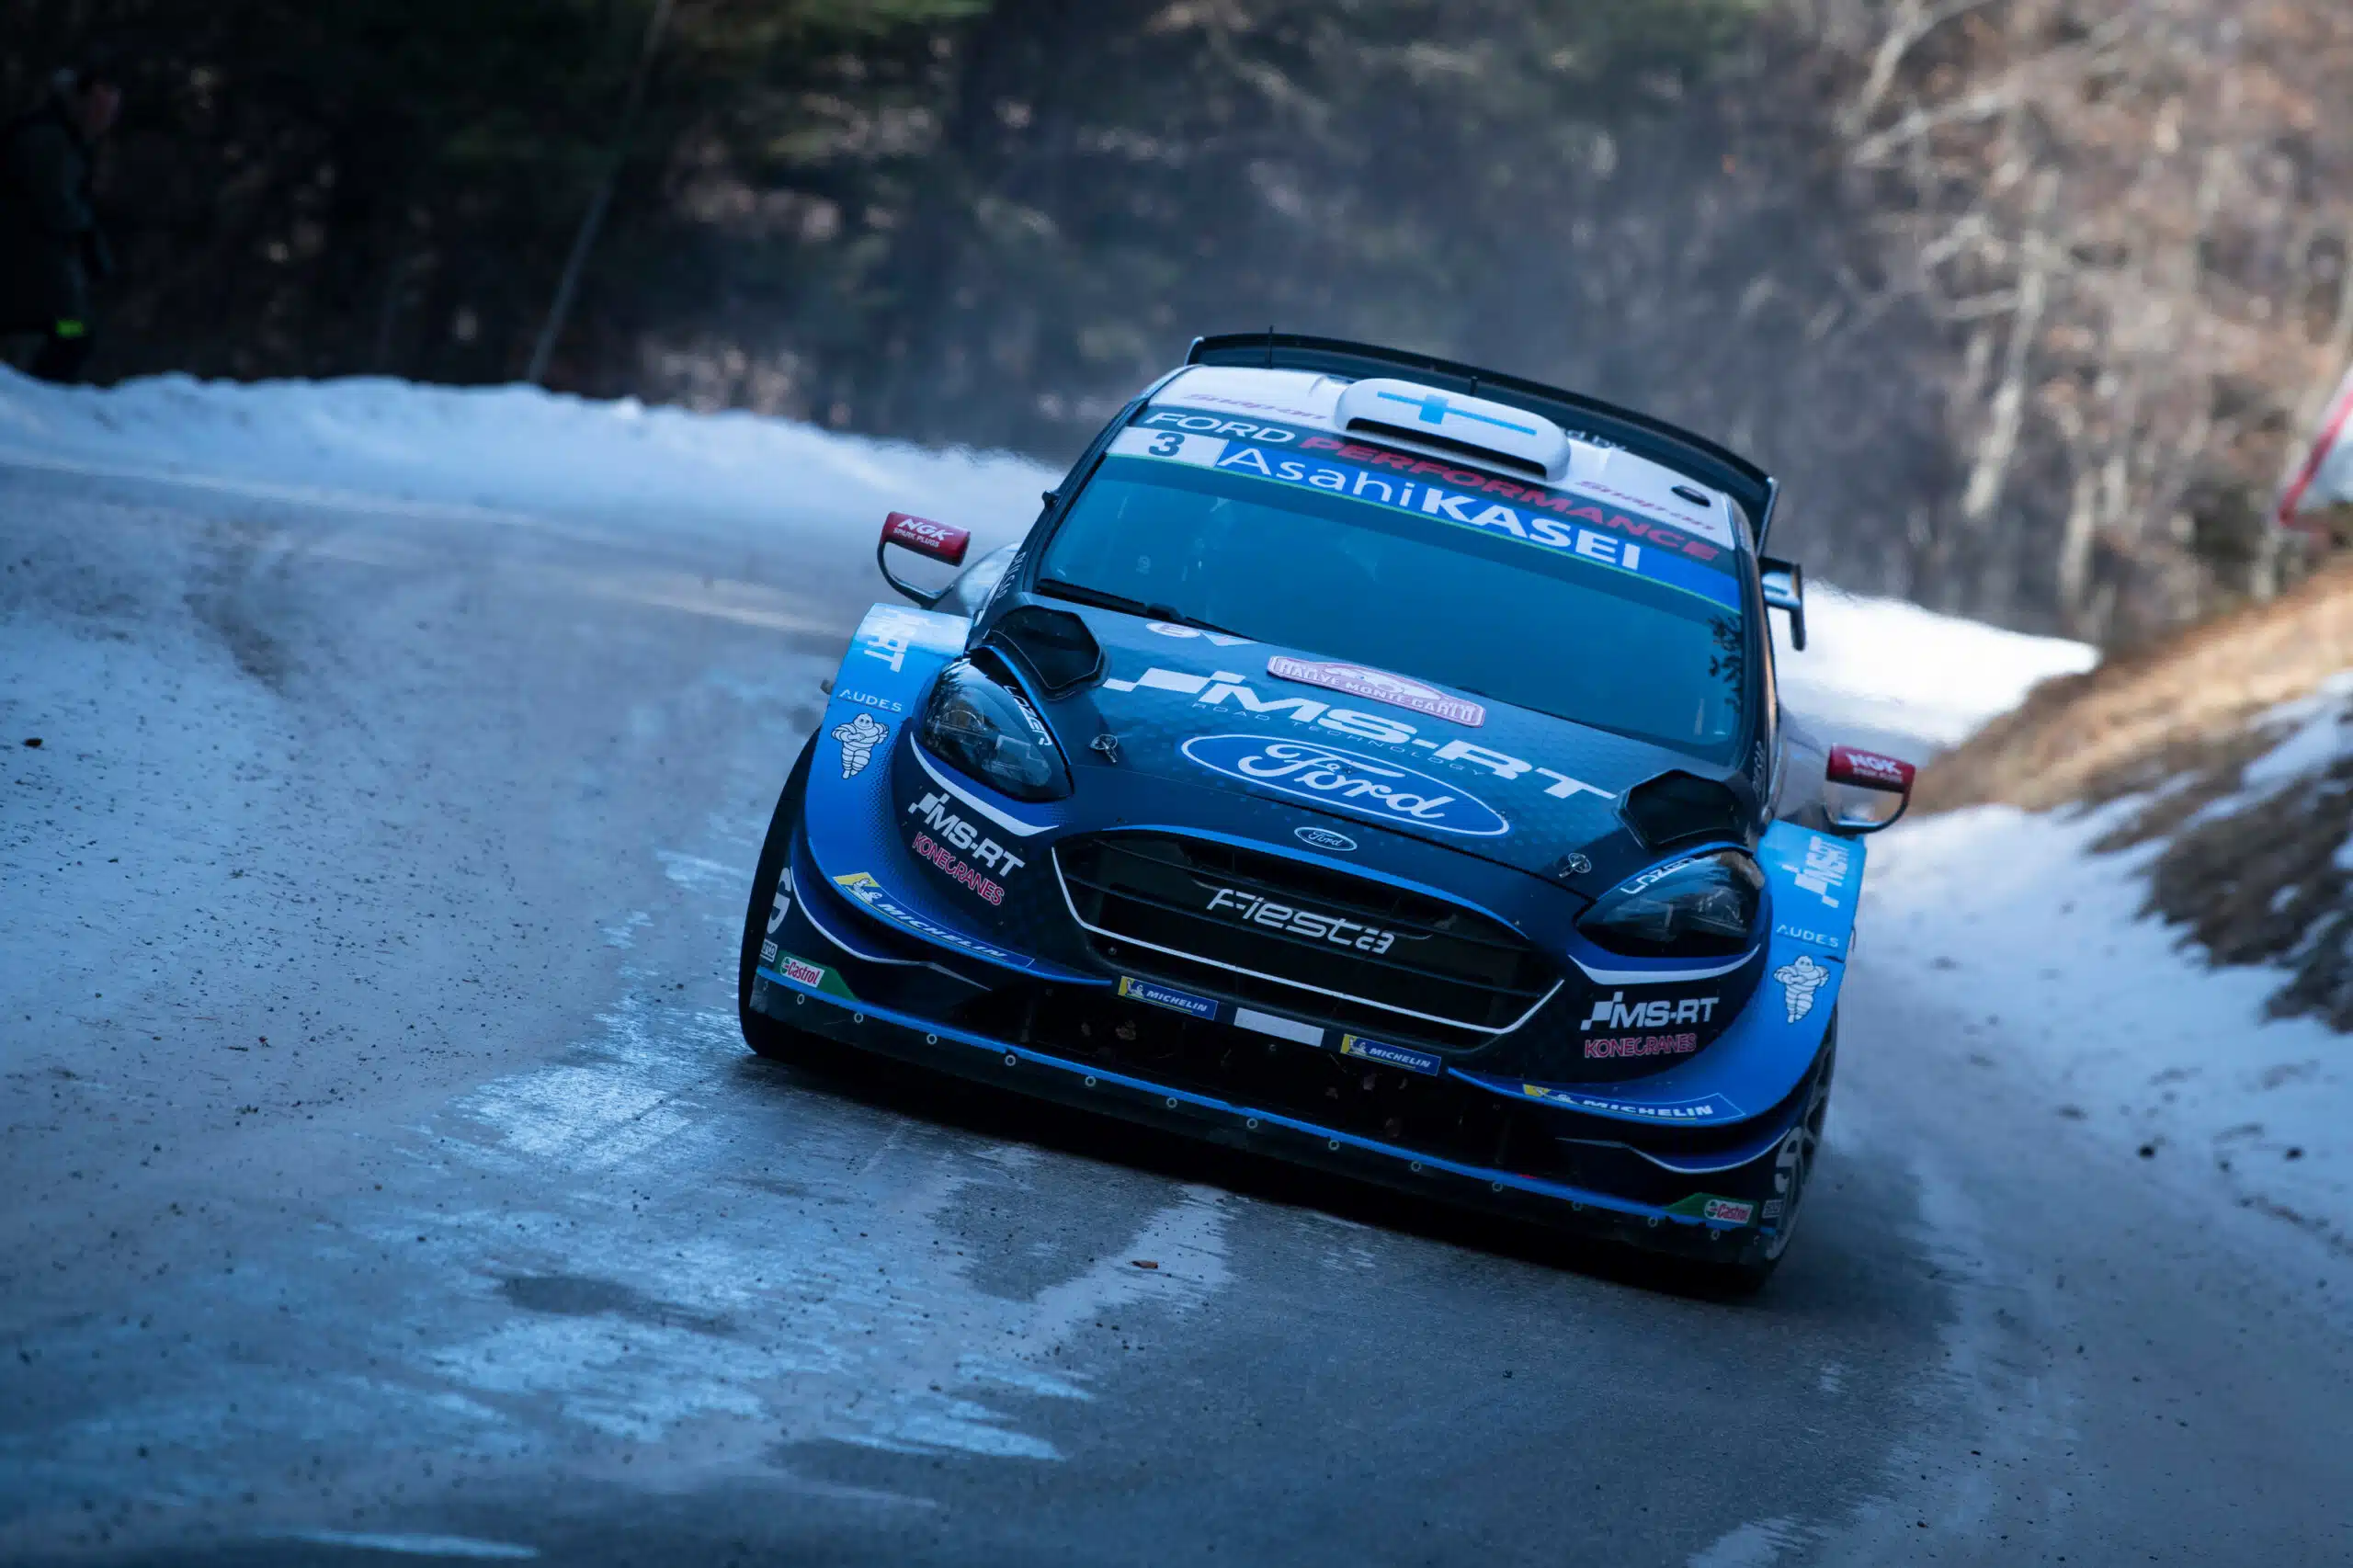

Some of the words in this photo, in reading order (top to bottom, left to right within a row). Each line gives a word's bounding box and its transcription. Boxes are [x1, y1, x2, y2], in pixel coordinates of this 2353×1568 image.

[1149, 429, 1185, 457] 3
[1144, 412, 1295, 443] FORD
[1299, 437, 1719, 561] PERFORMANCE
[893, 528, 916, 540] SPARK
[916, 535, 940, 549] PLUGS
[897, 517, 954, 540] NGK
[839, 689, 903, 712] AUDES
[1346, 682, 1405, 703] MONTE
[1192, 702, 1270, 721] ROAD
[1293, 721, 1487, 776] TECHNOLOGY
[1199, 682, 1618, 799] MS-RT
[1238, 744, 1457, 818] Ford
[924, 803, 1026, 877] MS-RT
[1308, 831, 1343, 847] Ford
[912, 831, 1005, 905] KONECRANES
[878, 903, 1008, 958] MICHELIN
[1206, 888, 1395, 955] Fiesta
[1776, 924, 1839, 948] AUDES
[788, 960, 821, 985] Castrol
[1146, 990, 1209, 1012] MICHELIN
[1610, 995, 1721, 1028] MS-RT
[1369, 1046, 1432, 1068] MICHELIN
[1584, 1033, 1698, 1058] KONECRANES
[1582, 1099, 1714, 1118] MICHELIN
